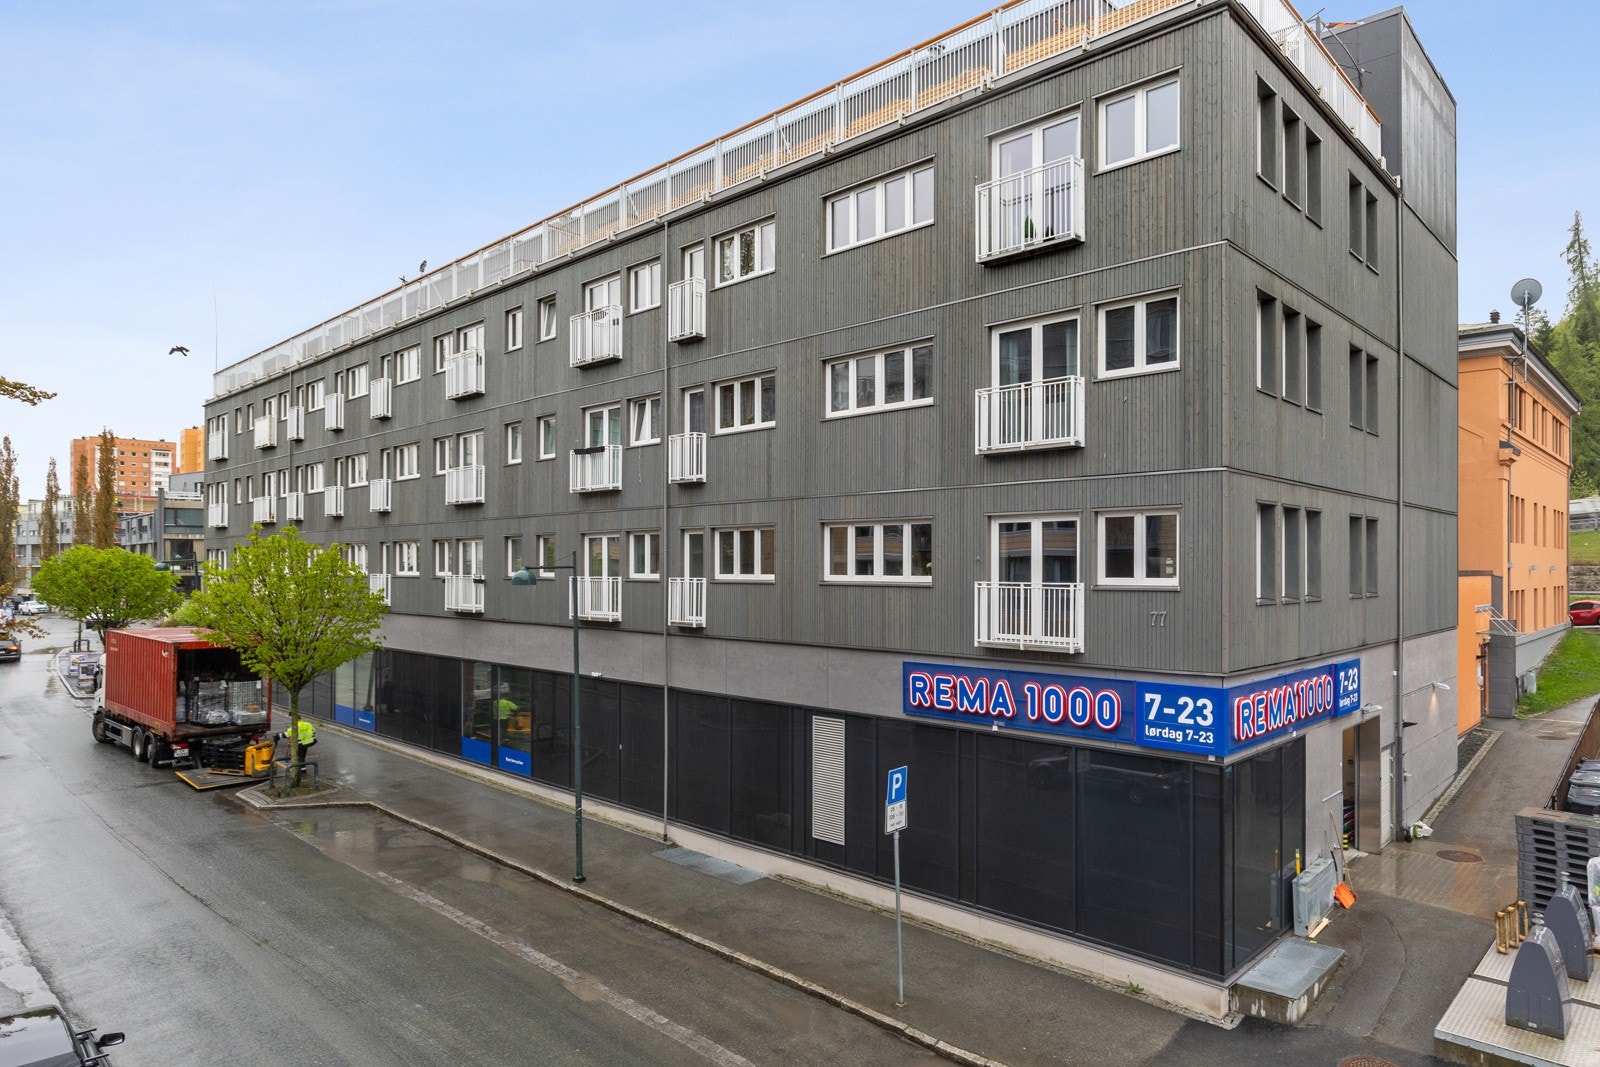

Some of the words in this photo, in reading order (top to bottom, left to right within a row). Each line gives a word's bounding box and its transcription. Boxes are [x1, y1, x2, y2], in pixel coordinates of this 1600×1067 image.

[1150, 611, 1167, 626] 77
[1339, 667, 1358, 694] 7-23
[909, 671, 1016, 718] REMA
[1024, 681, 1122, 731] 1000
[1145, 693, 1214, 726] 7-23
[1234, 685, 1296, 741] REMA
[1295, 674, 1333, 720] 1000
[1145, 724, 1183, 742] lørdag
[1186, 729, 1214, 743] 7-23
[892, 773, 902, 799] P
